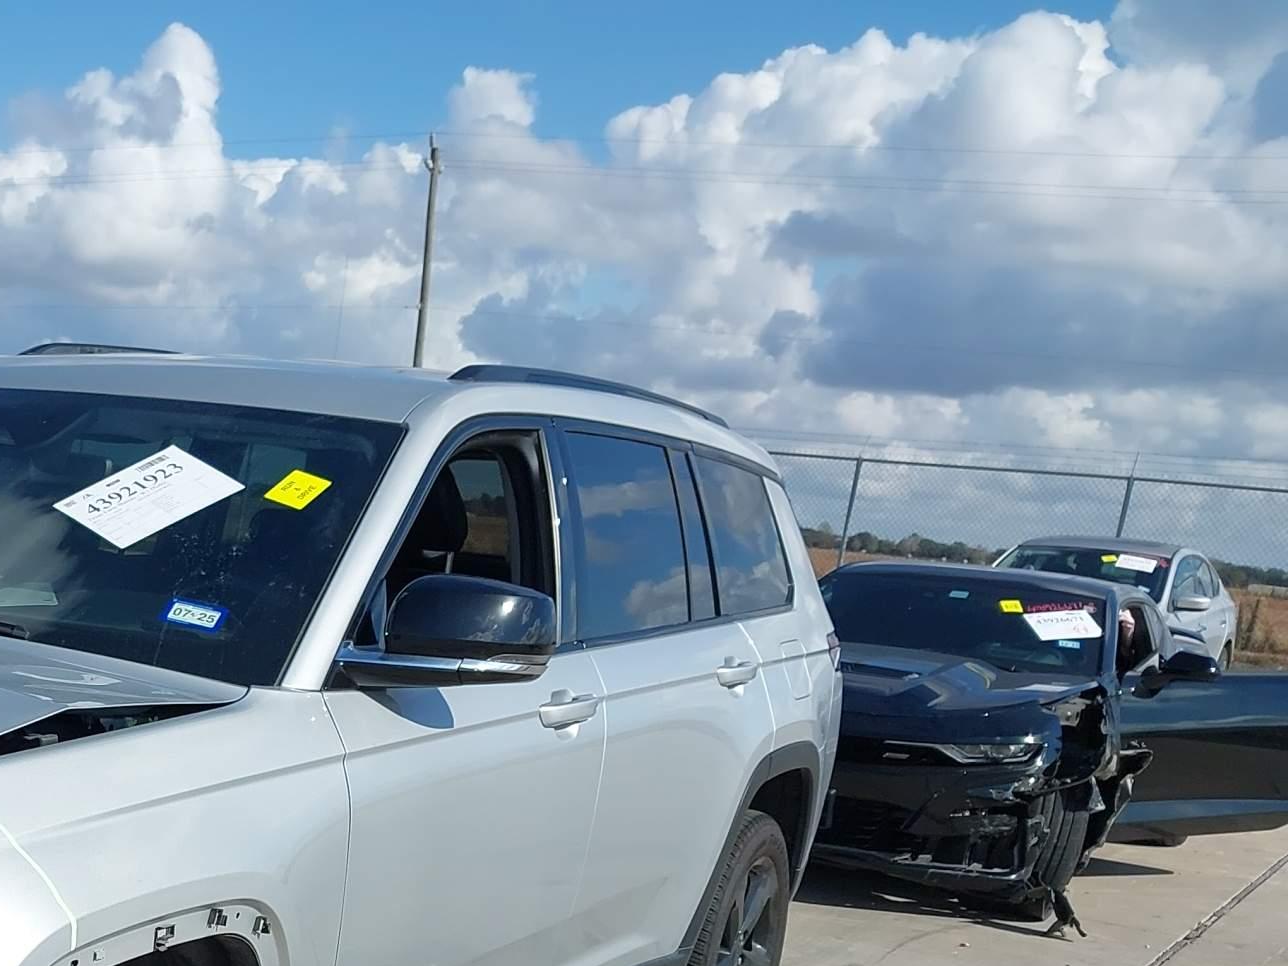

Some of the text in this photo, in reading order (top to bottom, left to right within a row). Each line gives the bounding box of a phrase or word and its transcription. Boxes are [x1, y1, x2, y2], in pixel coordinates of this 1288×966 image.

[87, 463, 184, 514] 43921923
[280, 481, 296, 492] RUN
[296, 484, 318, 500] DRIVE
